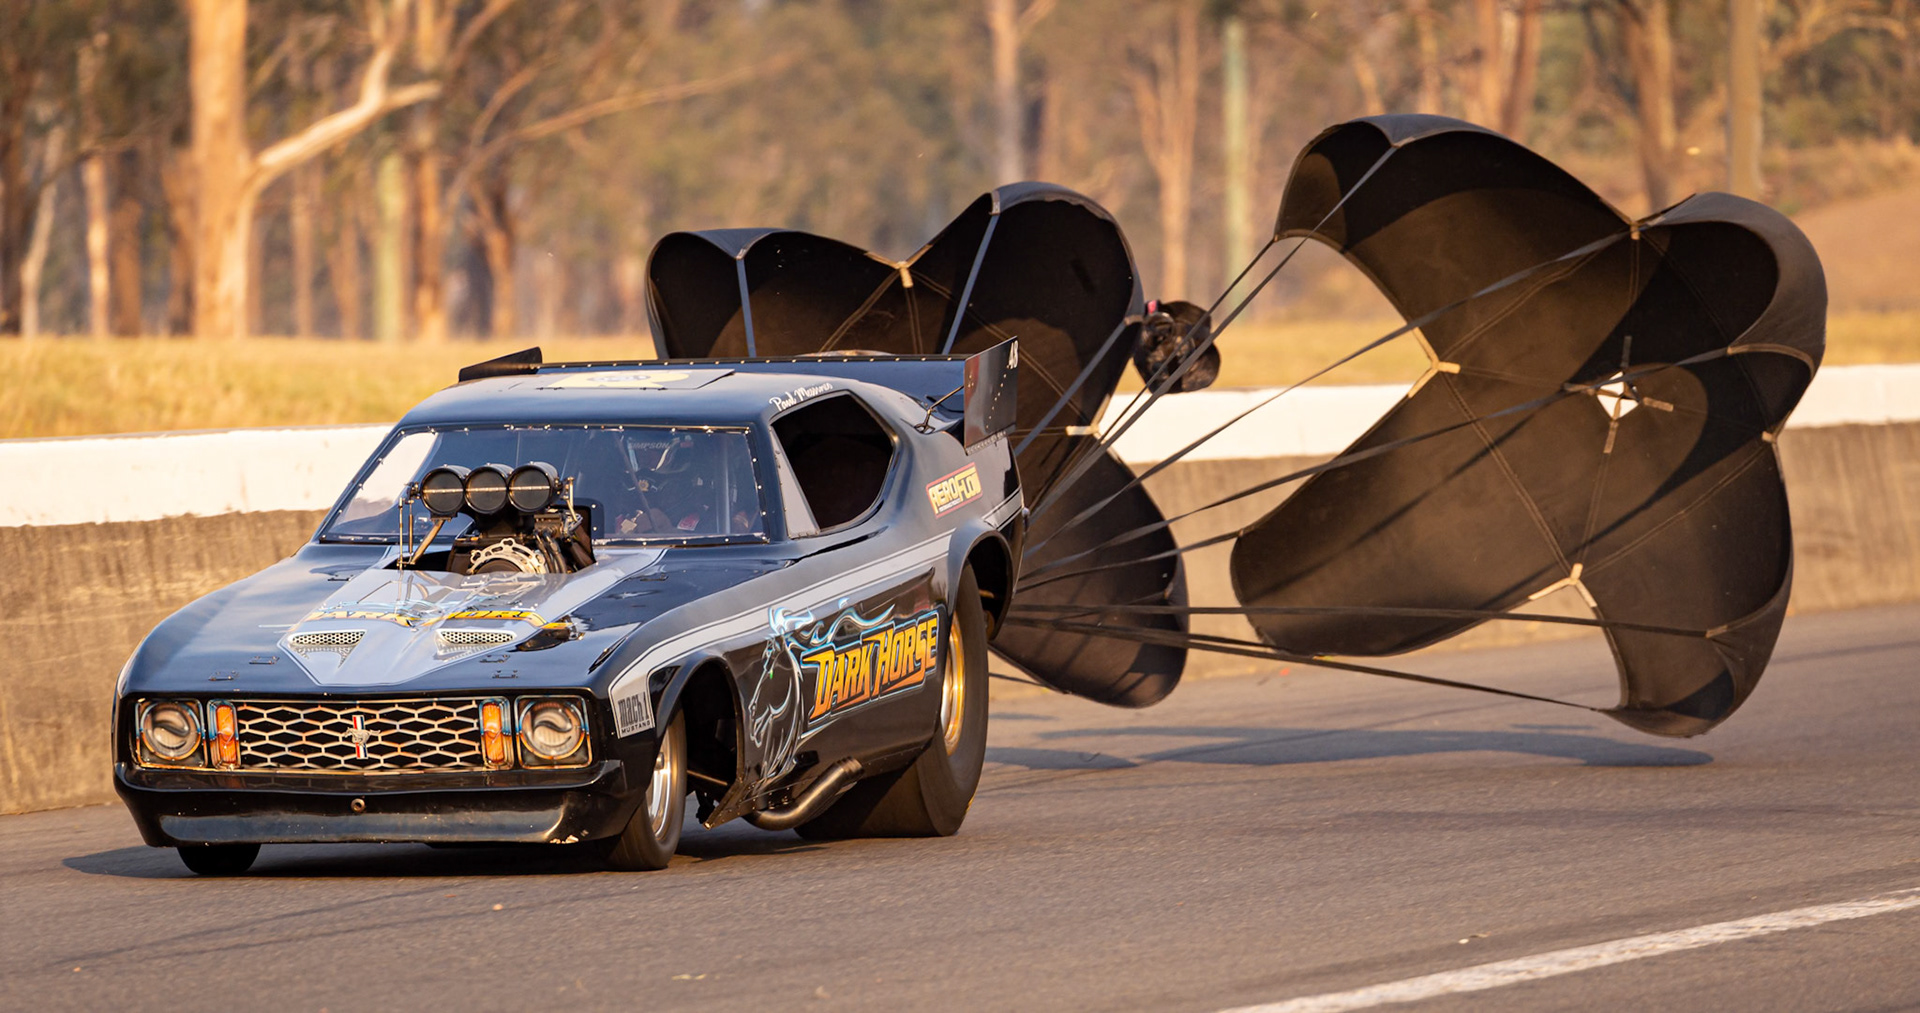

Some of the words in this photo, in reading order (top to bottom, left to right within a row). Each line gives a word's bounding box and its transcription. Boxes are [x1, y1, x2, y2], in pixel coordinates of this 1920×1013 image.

[802, 640, 876, 720] DARK
[862, 616, 938, 698] HORSE
[620, 720, 651, 734] MUSTANG
